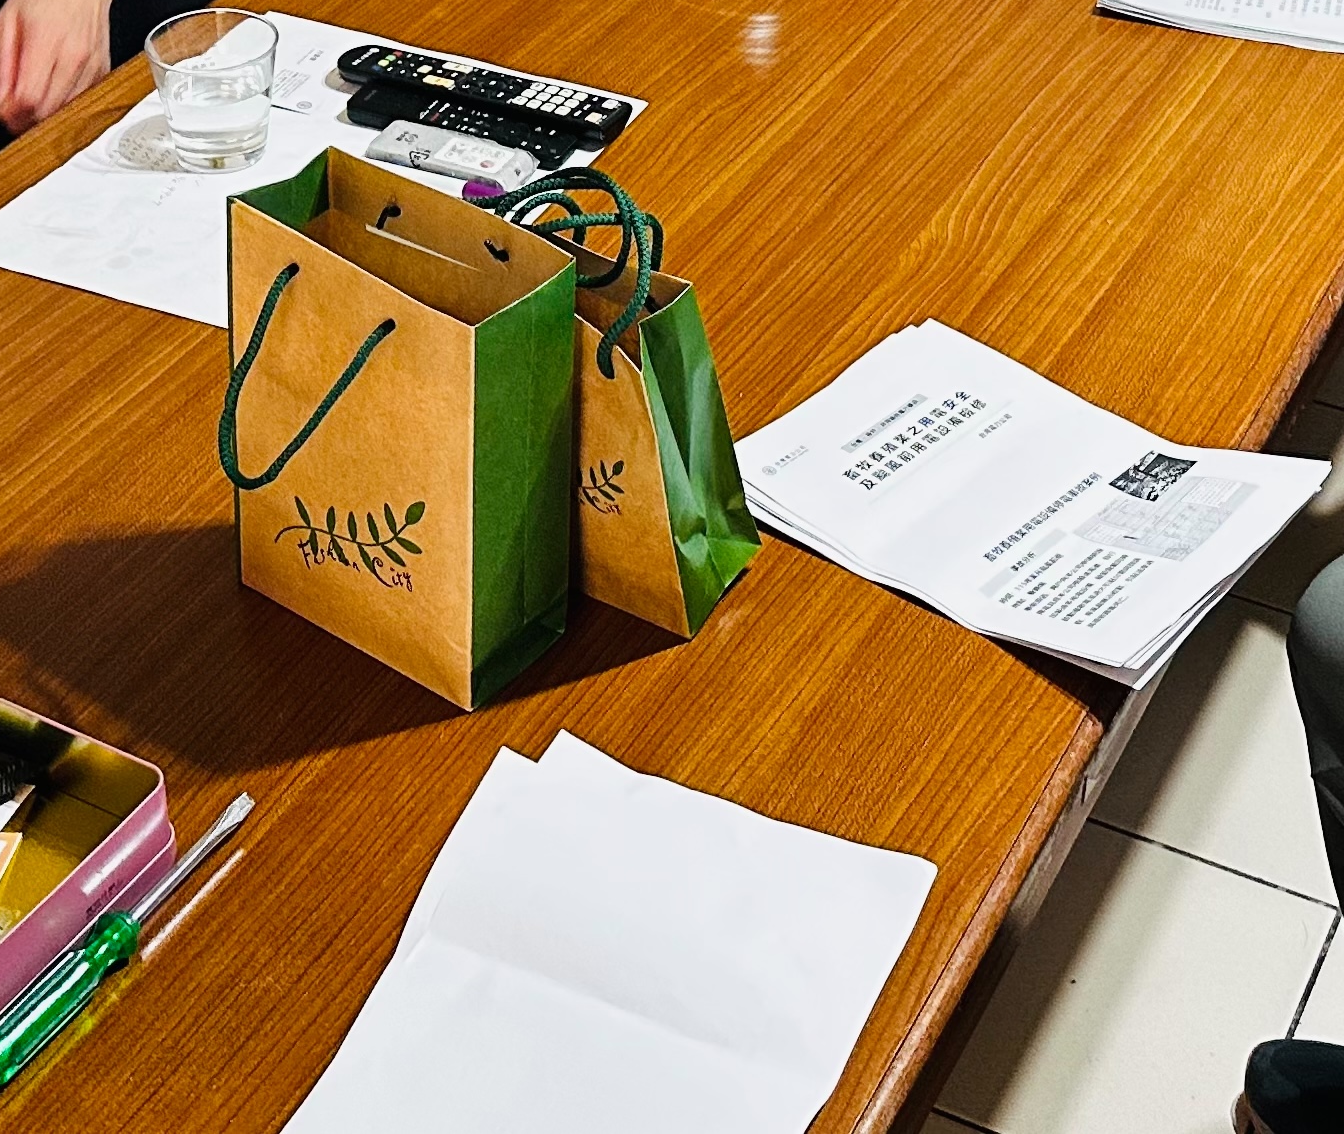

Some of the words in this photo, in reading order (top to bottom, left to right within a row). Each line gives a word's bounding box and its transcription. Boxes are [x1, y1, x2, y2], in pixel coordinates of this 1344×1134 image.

[842, 391, 971, 480] 畜牧養殖業之用電安全
[371, 556, 413, 592] City
